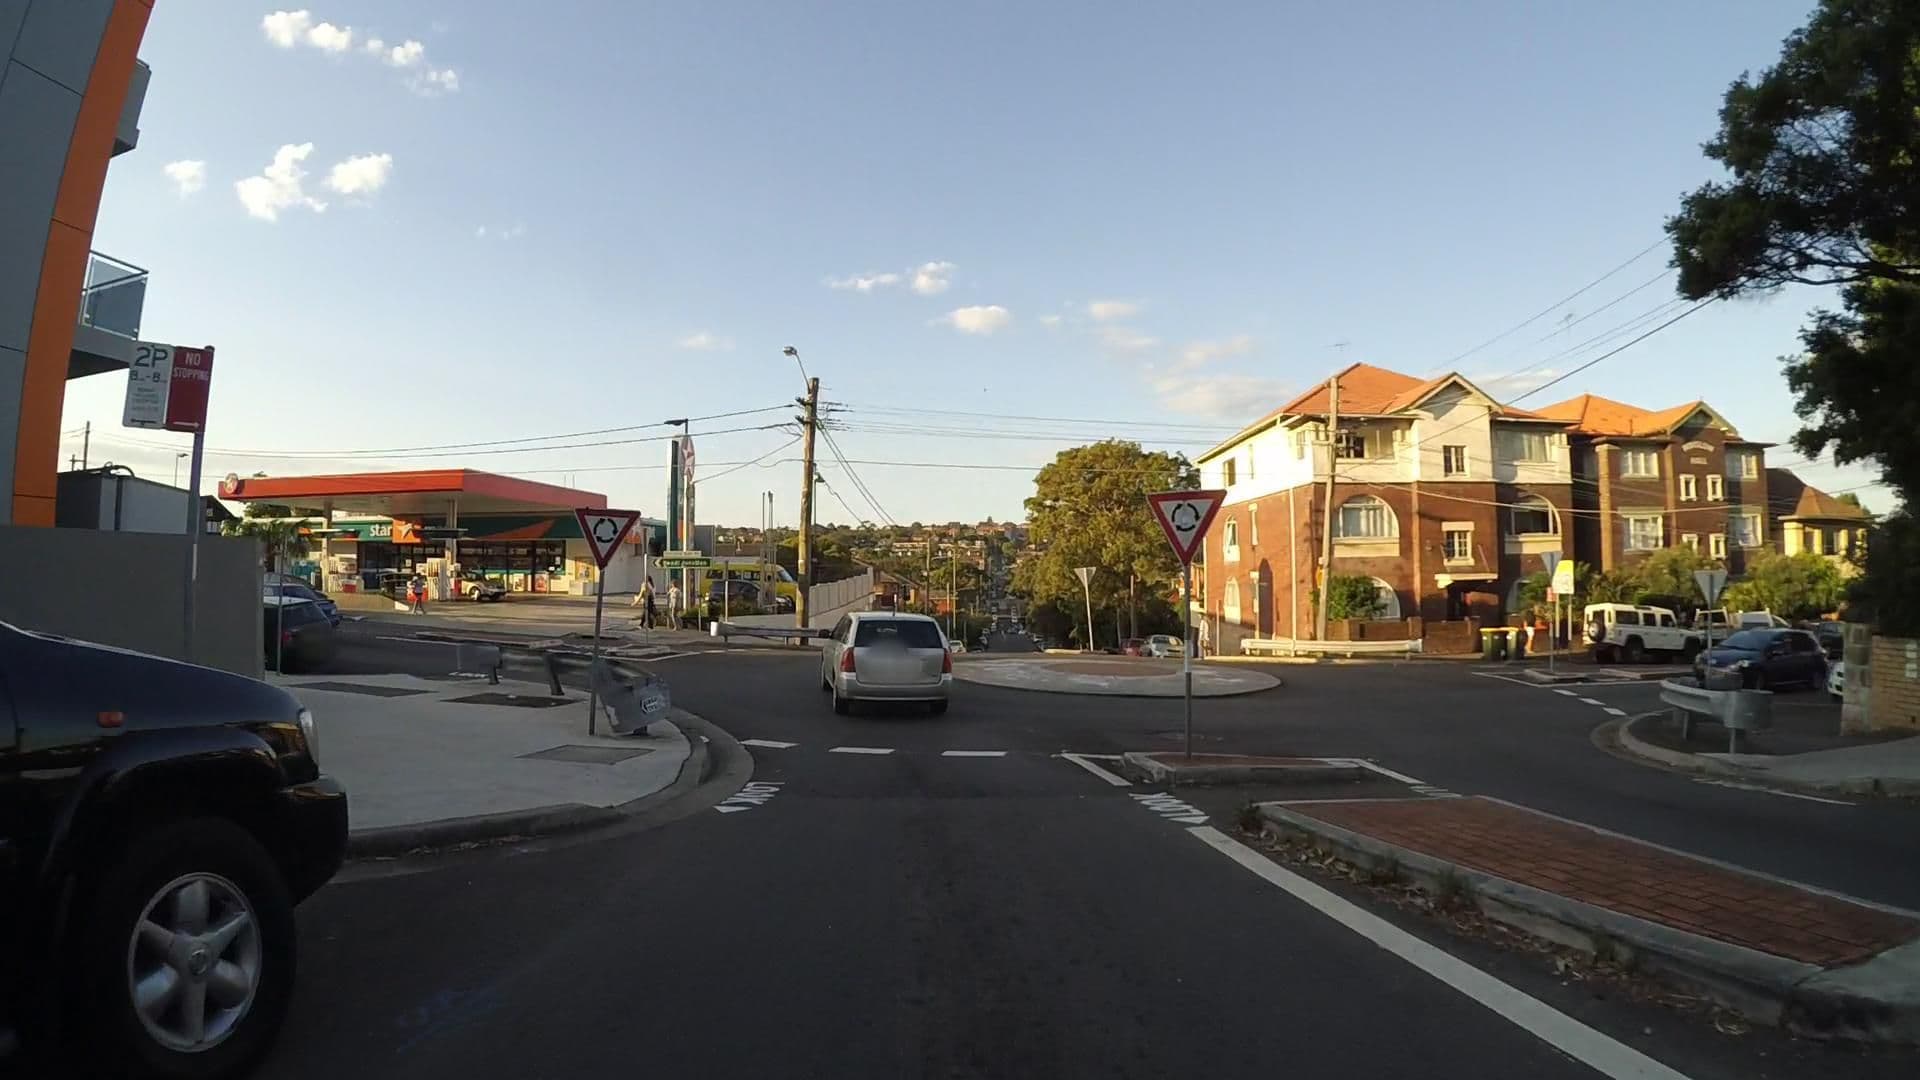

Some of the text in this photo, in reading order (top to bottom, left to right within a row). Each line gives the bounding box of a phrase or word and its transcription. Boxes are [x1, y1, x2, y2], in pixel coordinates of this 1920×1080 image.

[134, 345, 168, 368] 2P
[185, 352, 201, 366] NO
[173, 367, 209, 381] STOPPING
[369, 524, 392, 537] star
